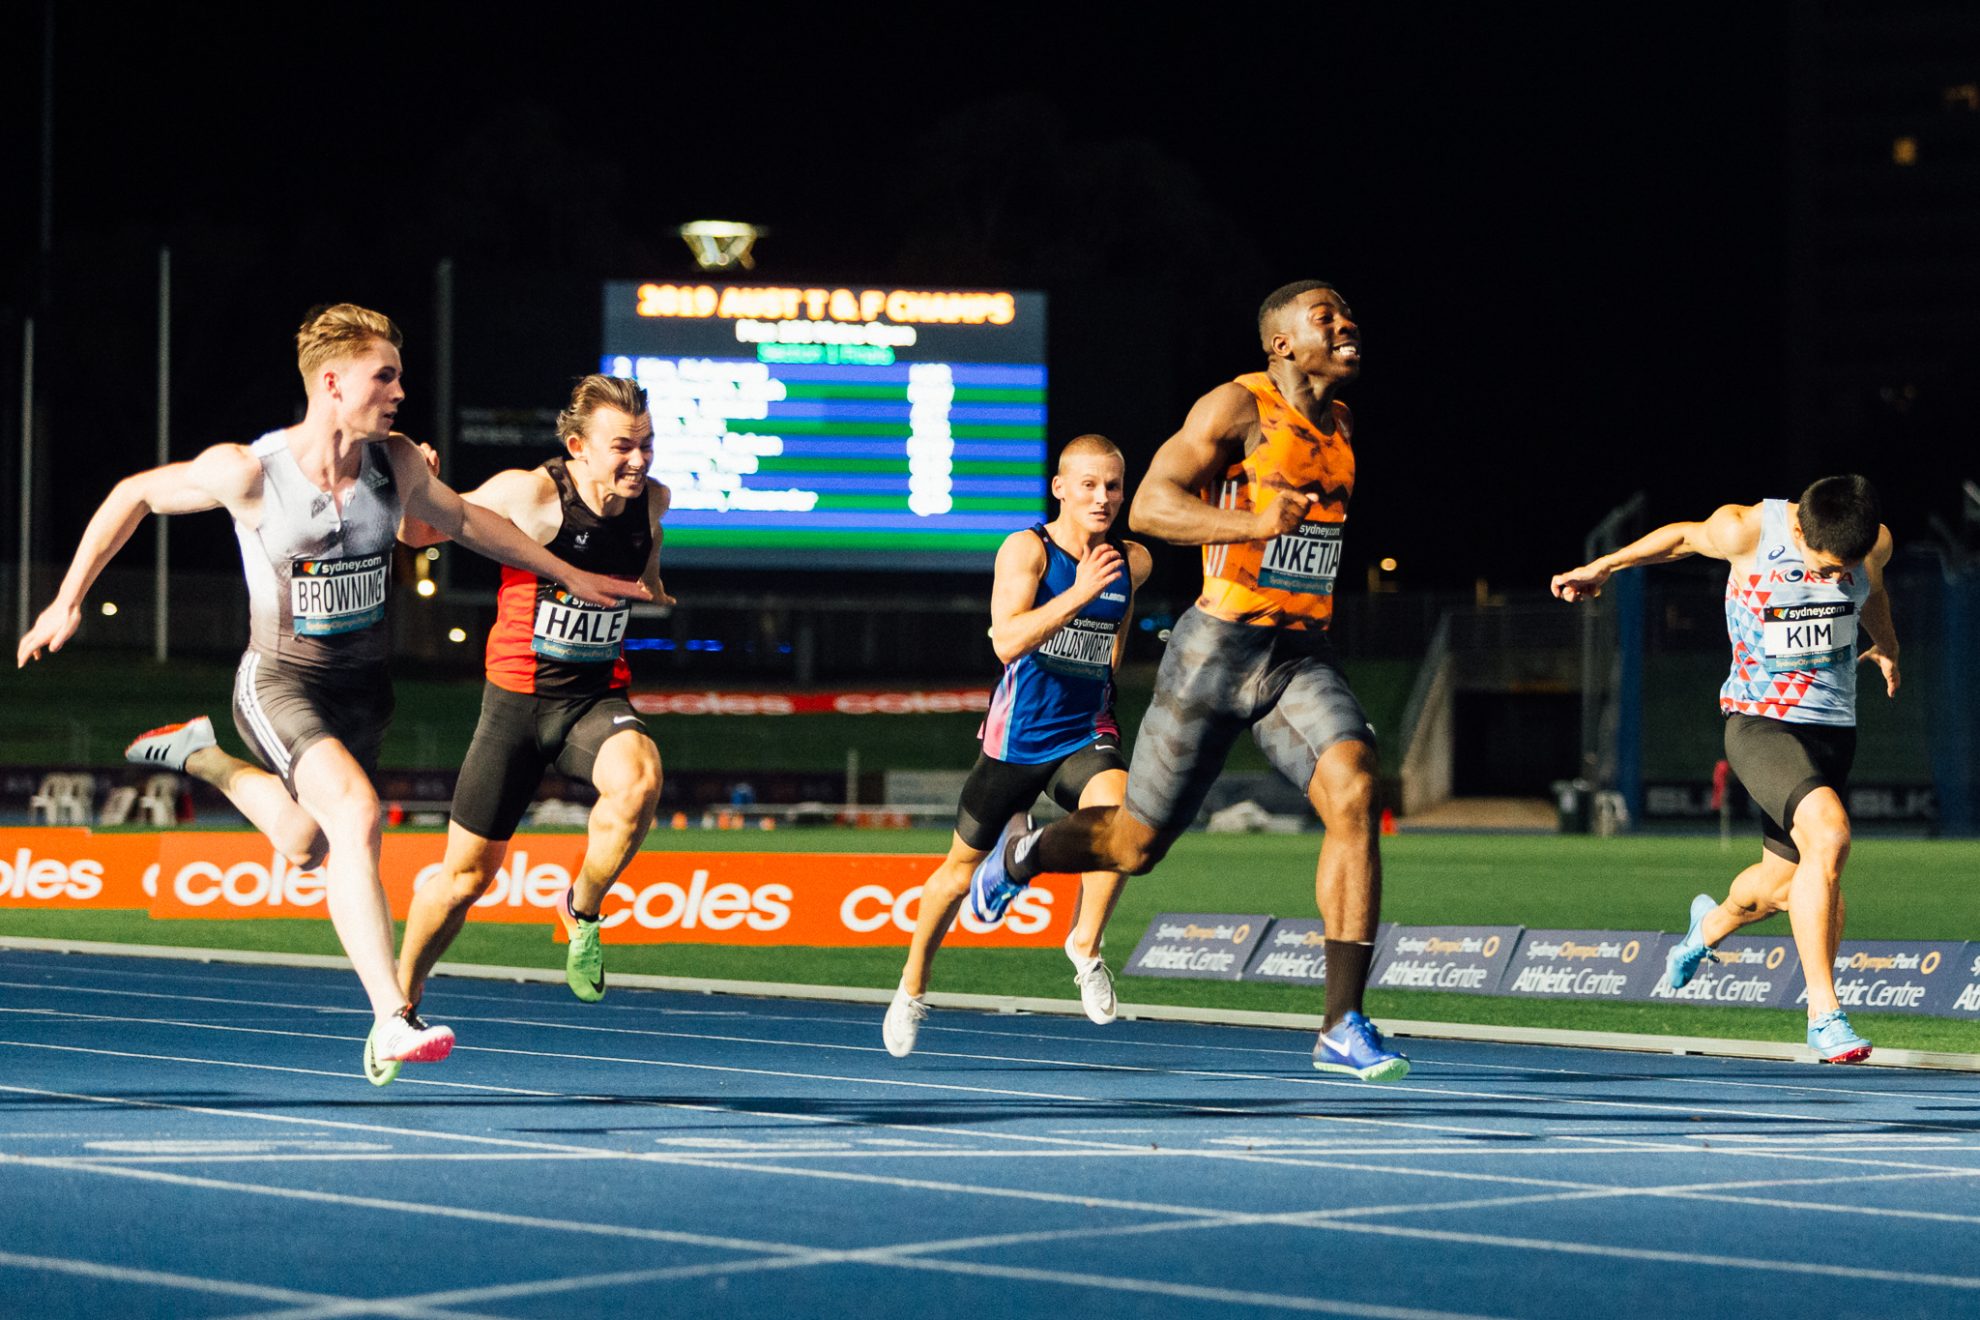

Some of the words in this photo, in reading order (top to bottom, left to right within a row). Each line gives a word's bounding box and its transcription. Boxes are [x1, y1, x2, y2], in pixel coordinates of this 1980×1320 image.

[322, 556, 382, 575] sydney.com
[1269, 536, 1340, 575] NKETIA
[298, 569, 383, 613] BROWNING
[545, 606, 624, 643] HALE
[1073, 618, 1114, 631] sydney.com
[1789, 606, 1846, 620] sydney.com
[1786, 623, 1832, 649] KIM
[1437, 962, 1487, 988] Centre
[1511, 965, 1576, 993] Athletic
[1573, 968, 1627, 995] Centre
[1715, 974, 1772, 1002] Centre
[1866, 979, 1925, 1008] Centre
